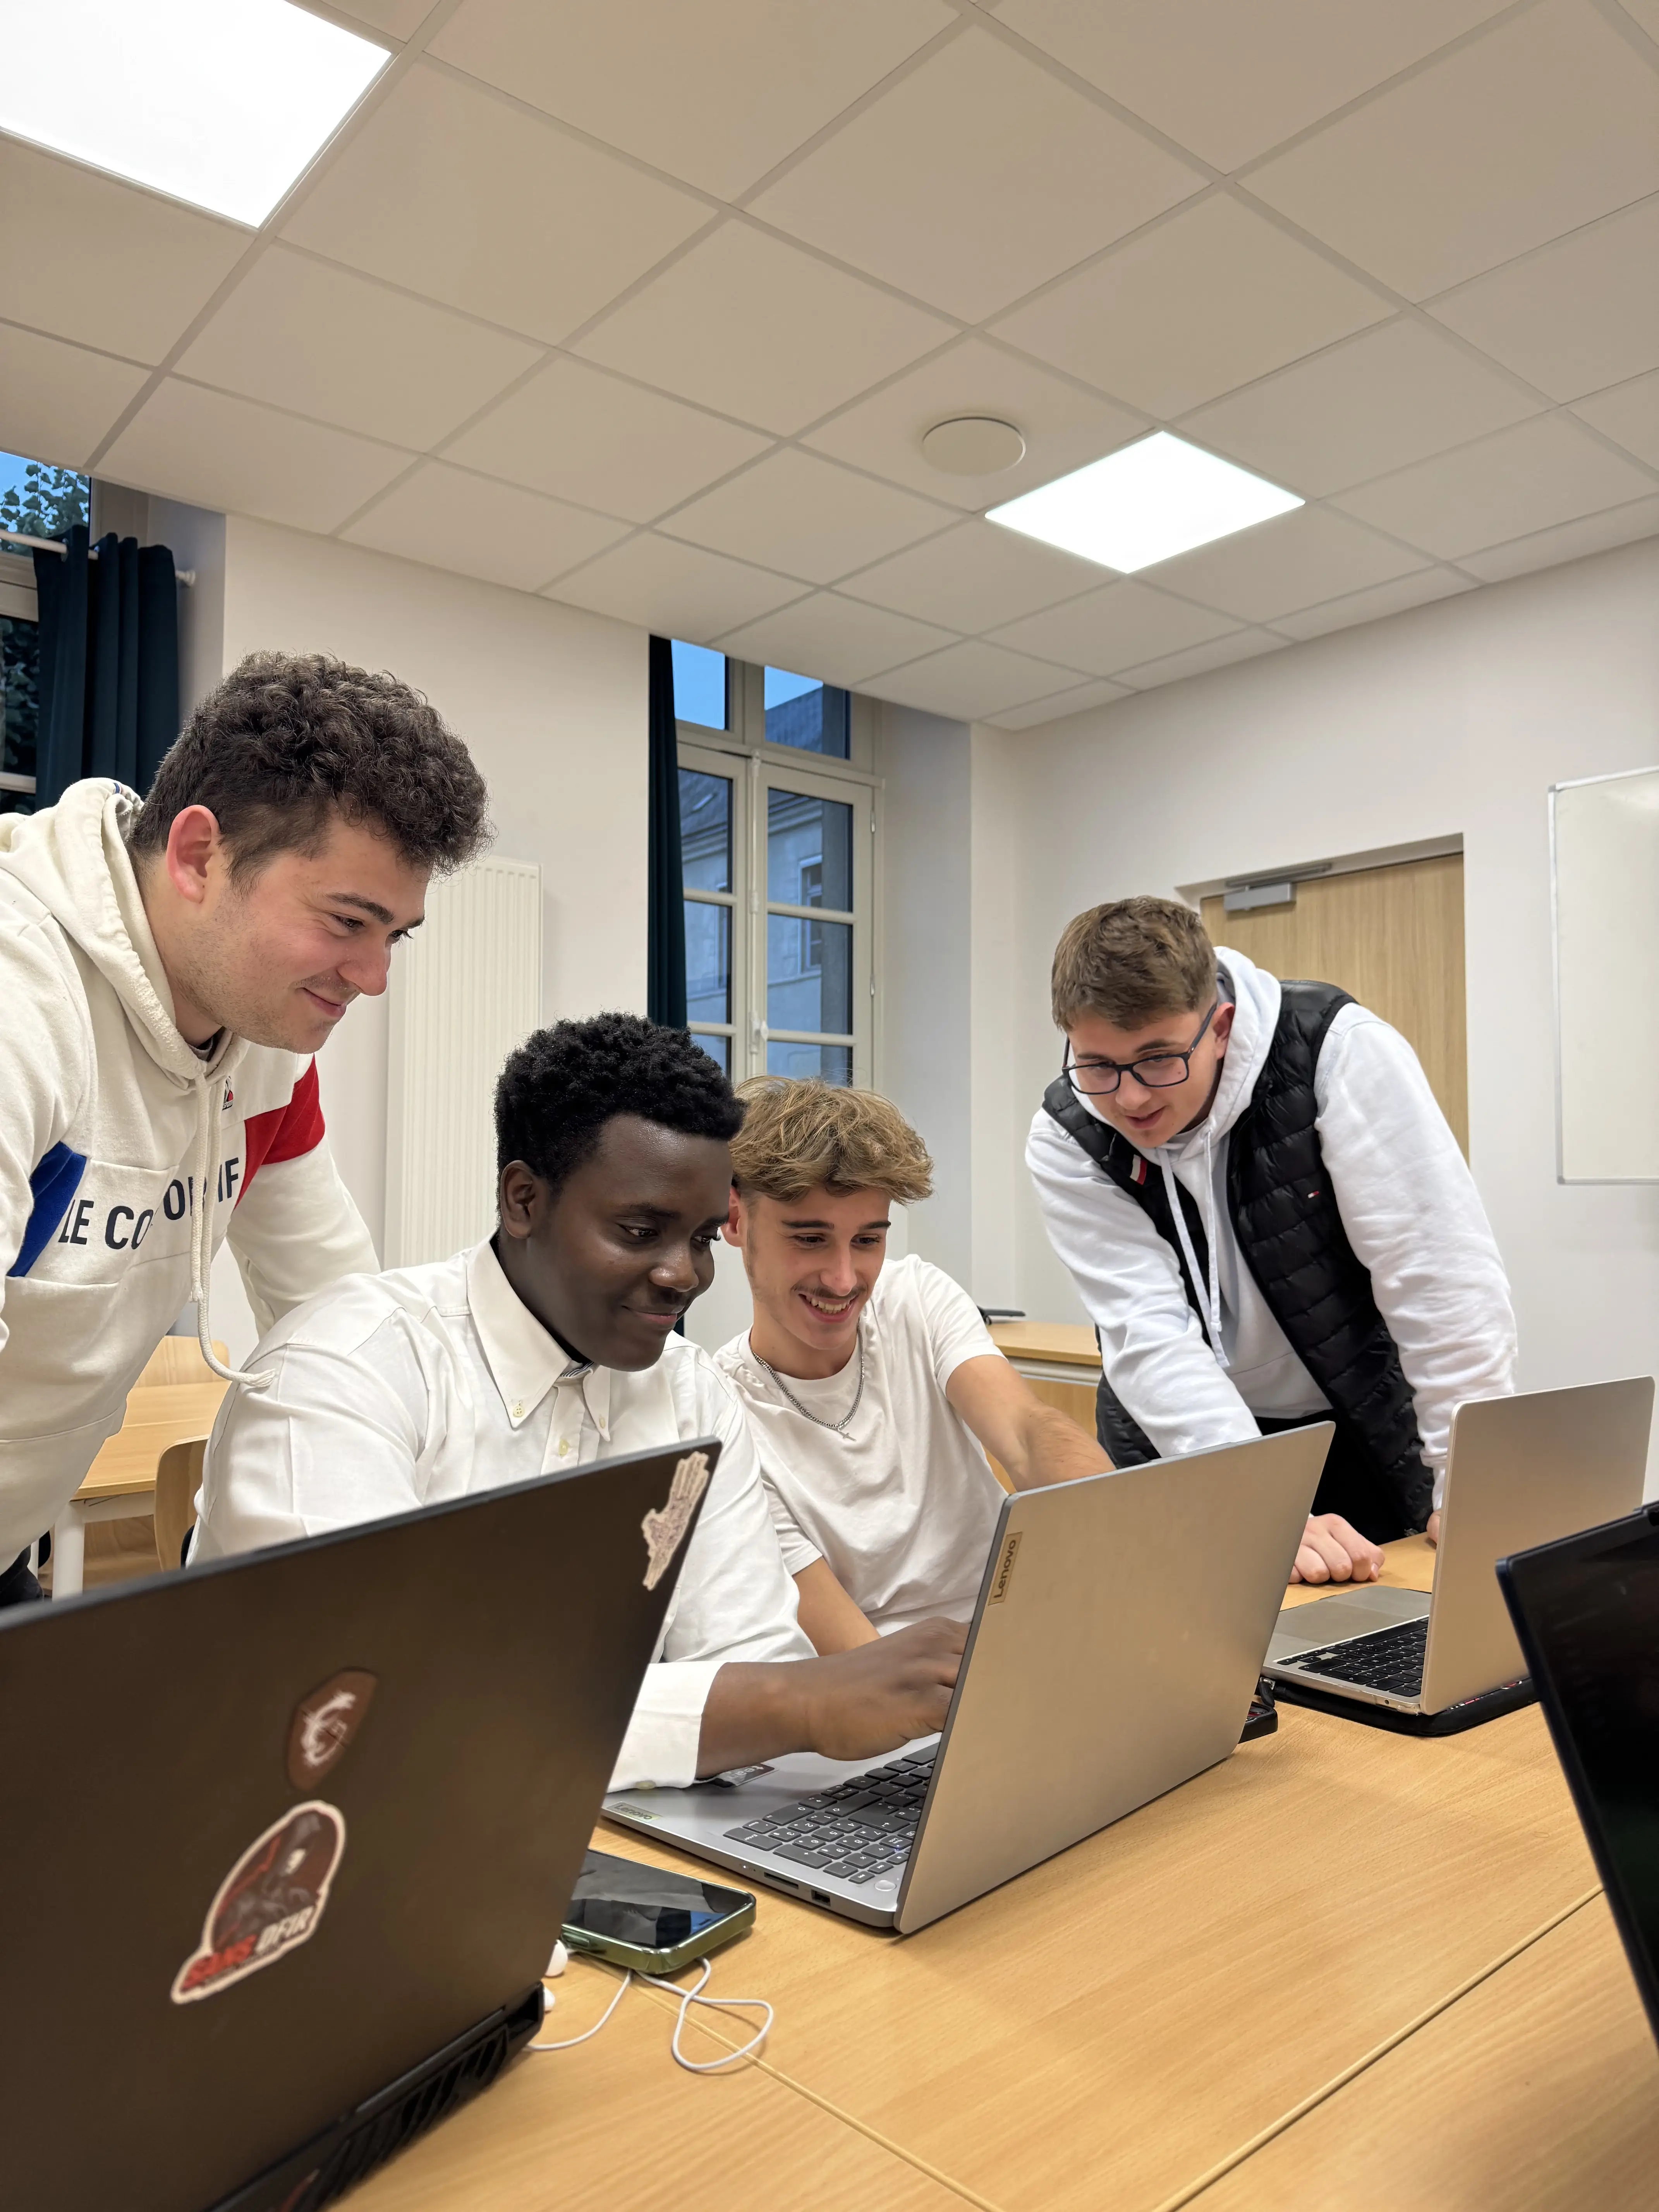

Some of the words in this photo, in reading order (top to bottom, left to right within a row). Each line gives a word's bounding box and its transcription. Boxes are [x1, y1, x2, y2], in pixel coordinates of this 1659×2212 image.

[58, 1199, 94, 1245] LE
[994, 1539, 1016, 1598] Lenovo
[614, 1805, 653, 1820] Lenovo
